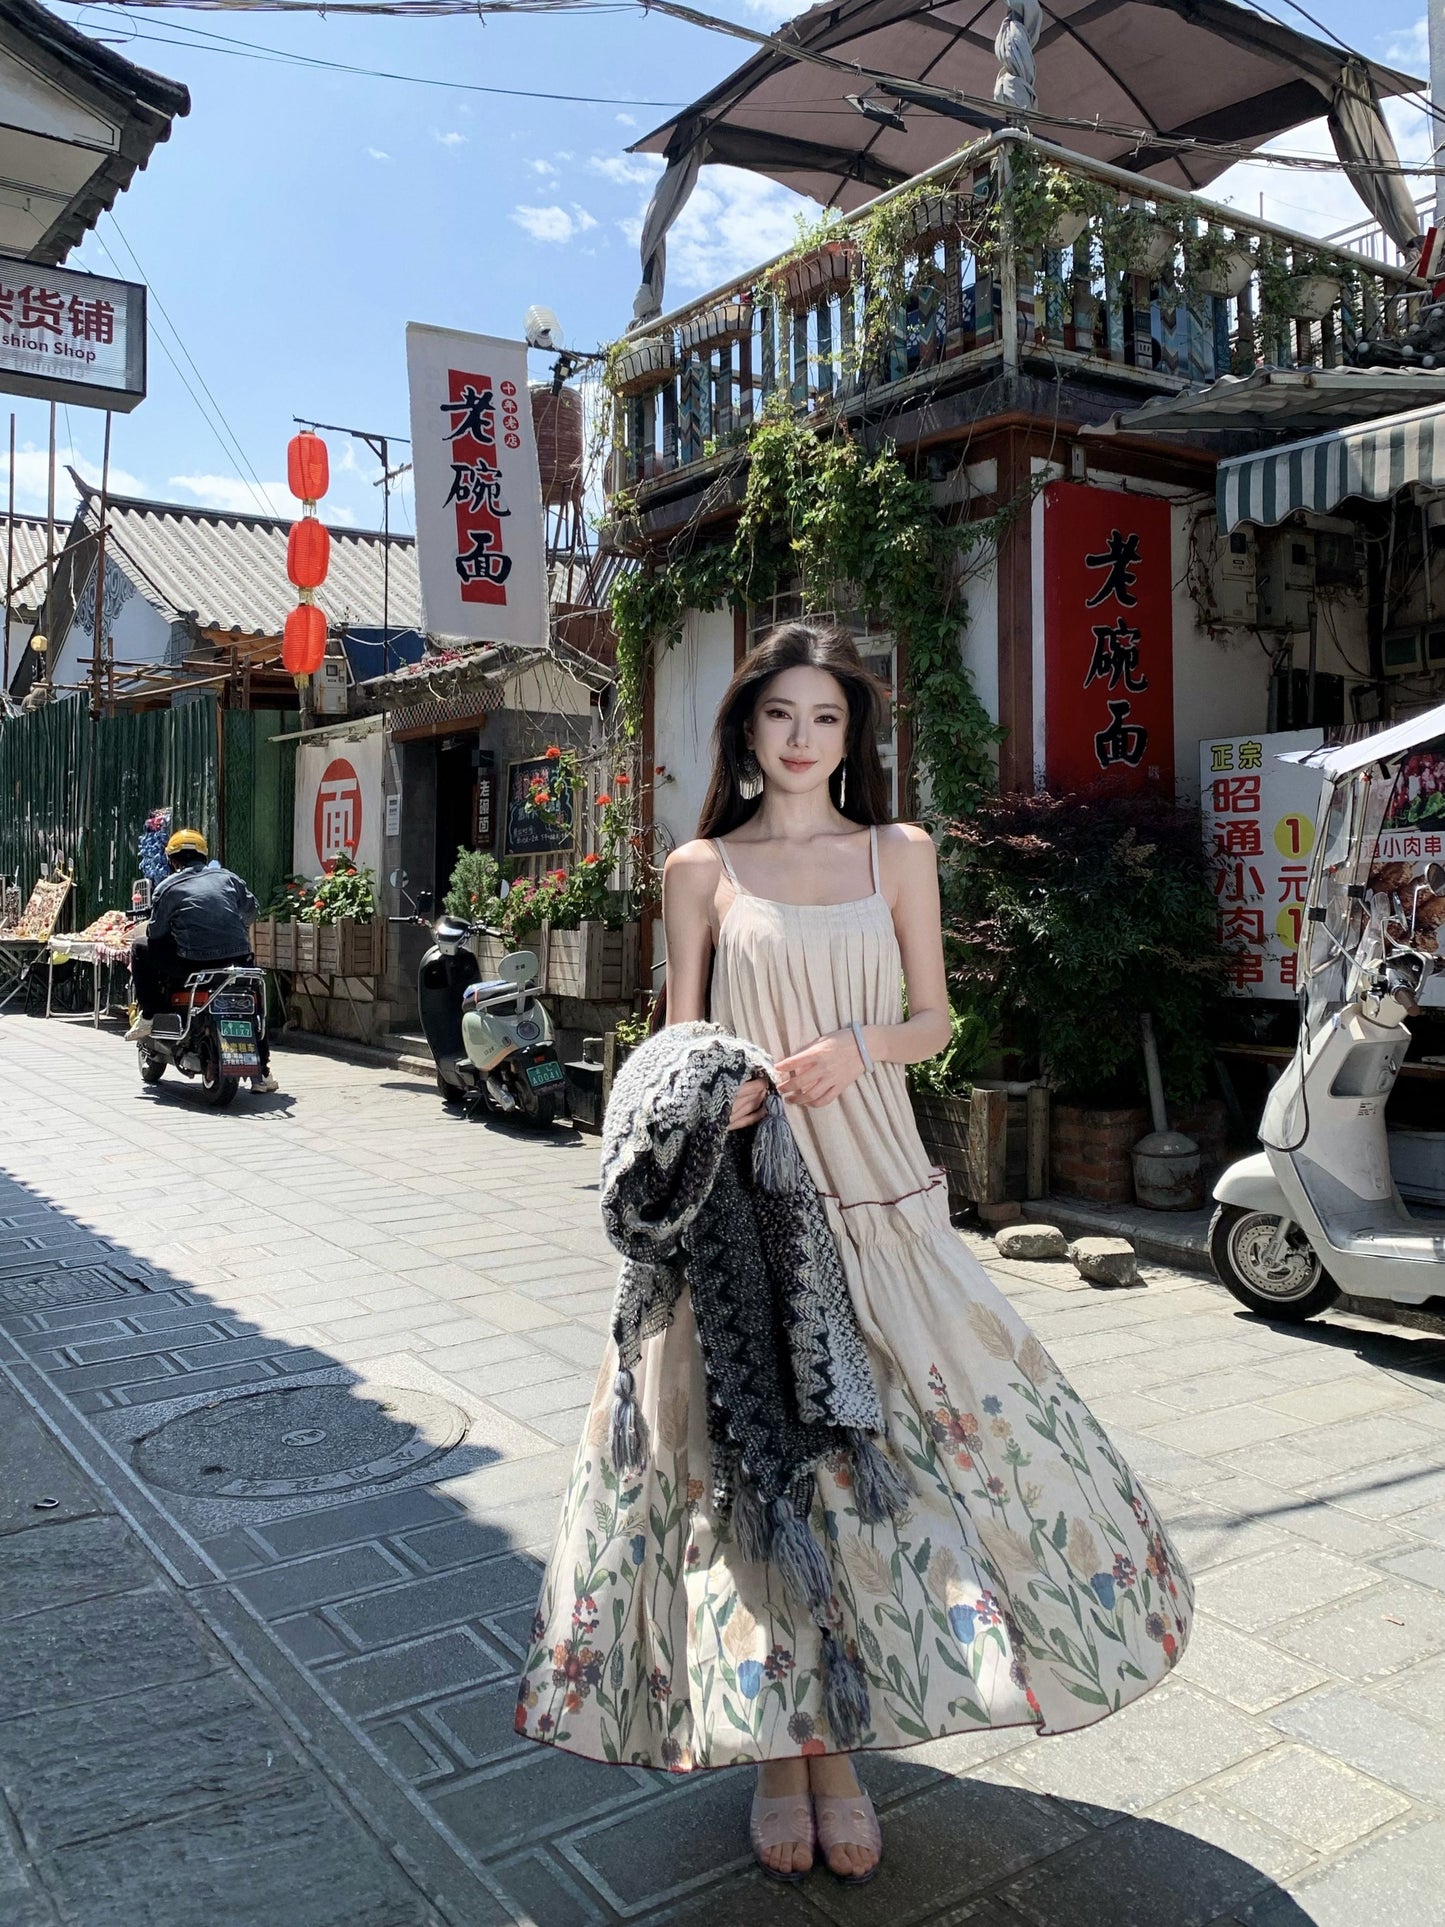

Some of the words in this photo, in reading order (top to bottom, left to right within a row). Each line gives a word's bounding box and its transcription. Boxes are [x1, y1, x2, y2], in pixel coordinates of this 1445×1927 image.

[53, 341, 97, 364] Shop
[500, 381, 520, 449] 十年老店
[440, 386, 512, 586] 老碗面
[1083, 529, 1149, 769] 老碗面
[1211, 741, 1263, 772] 正宗
